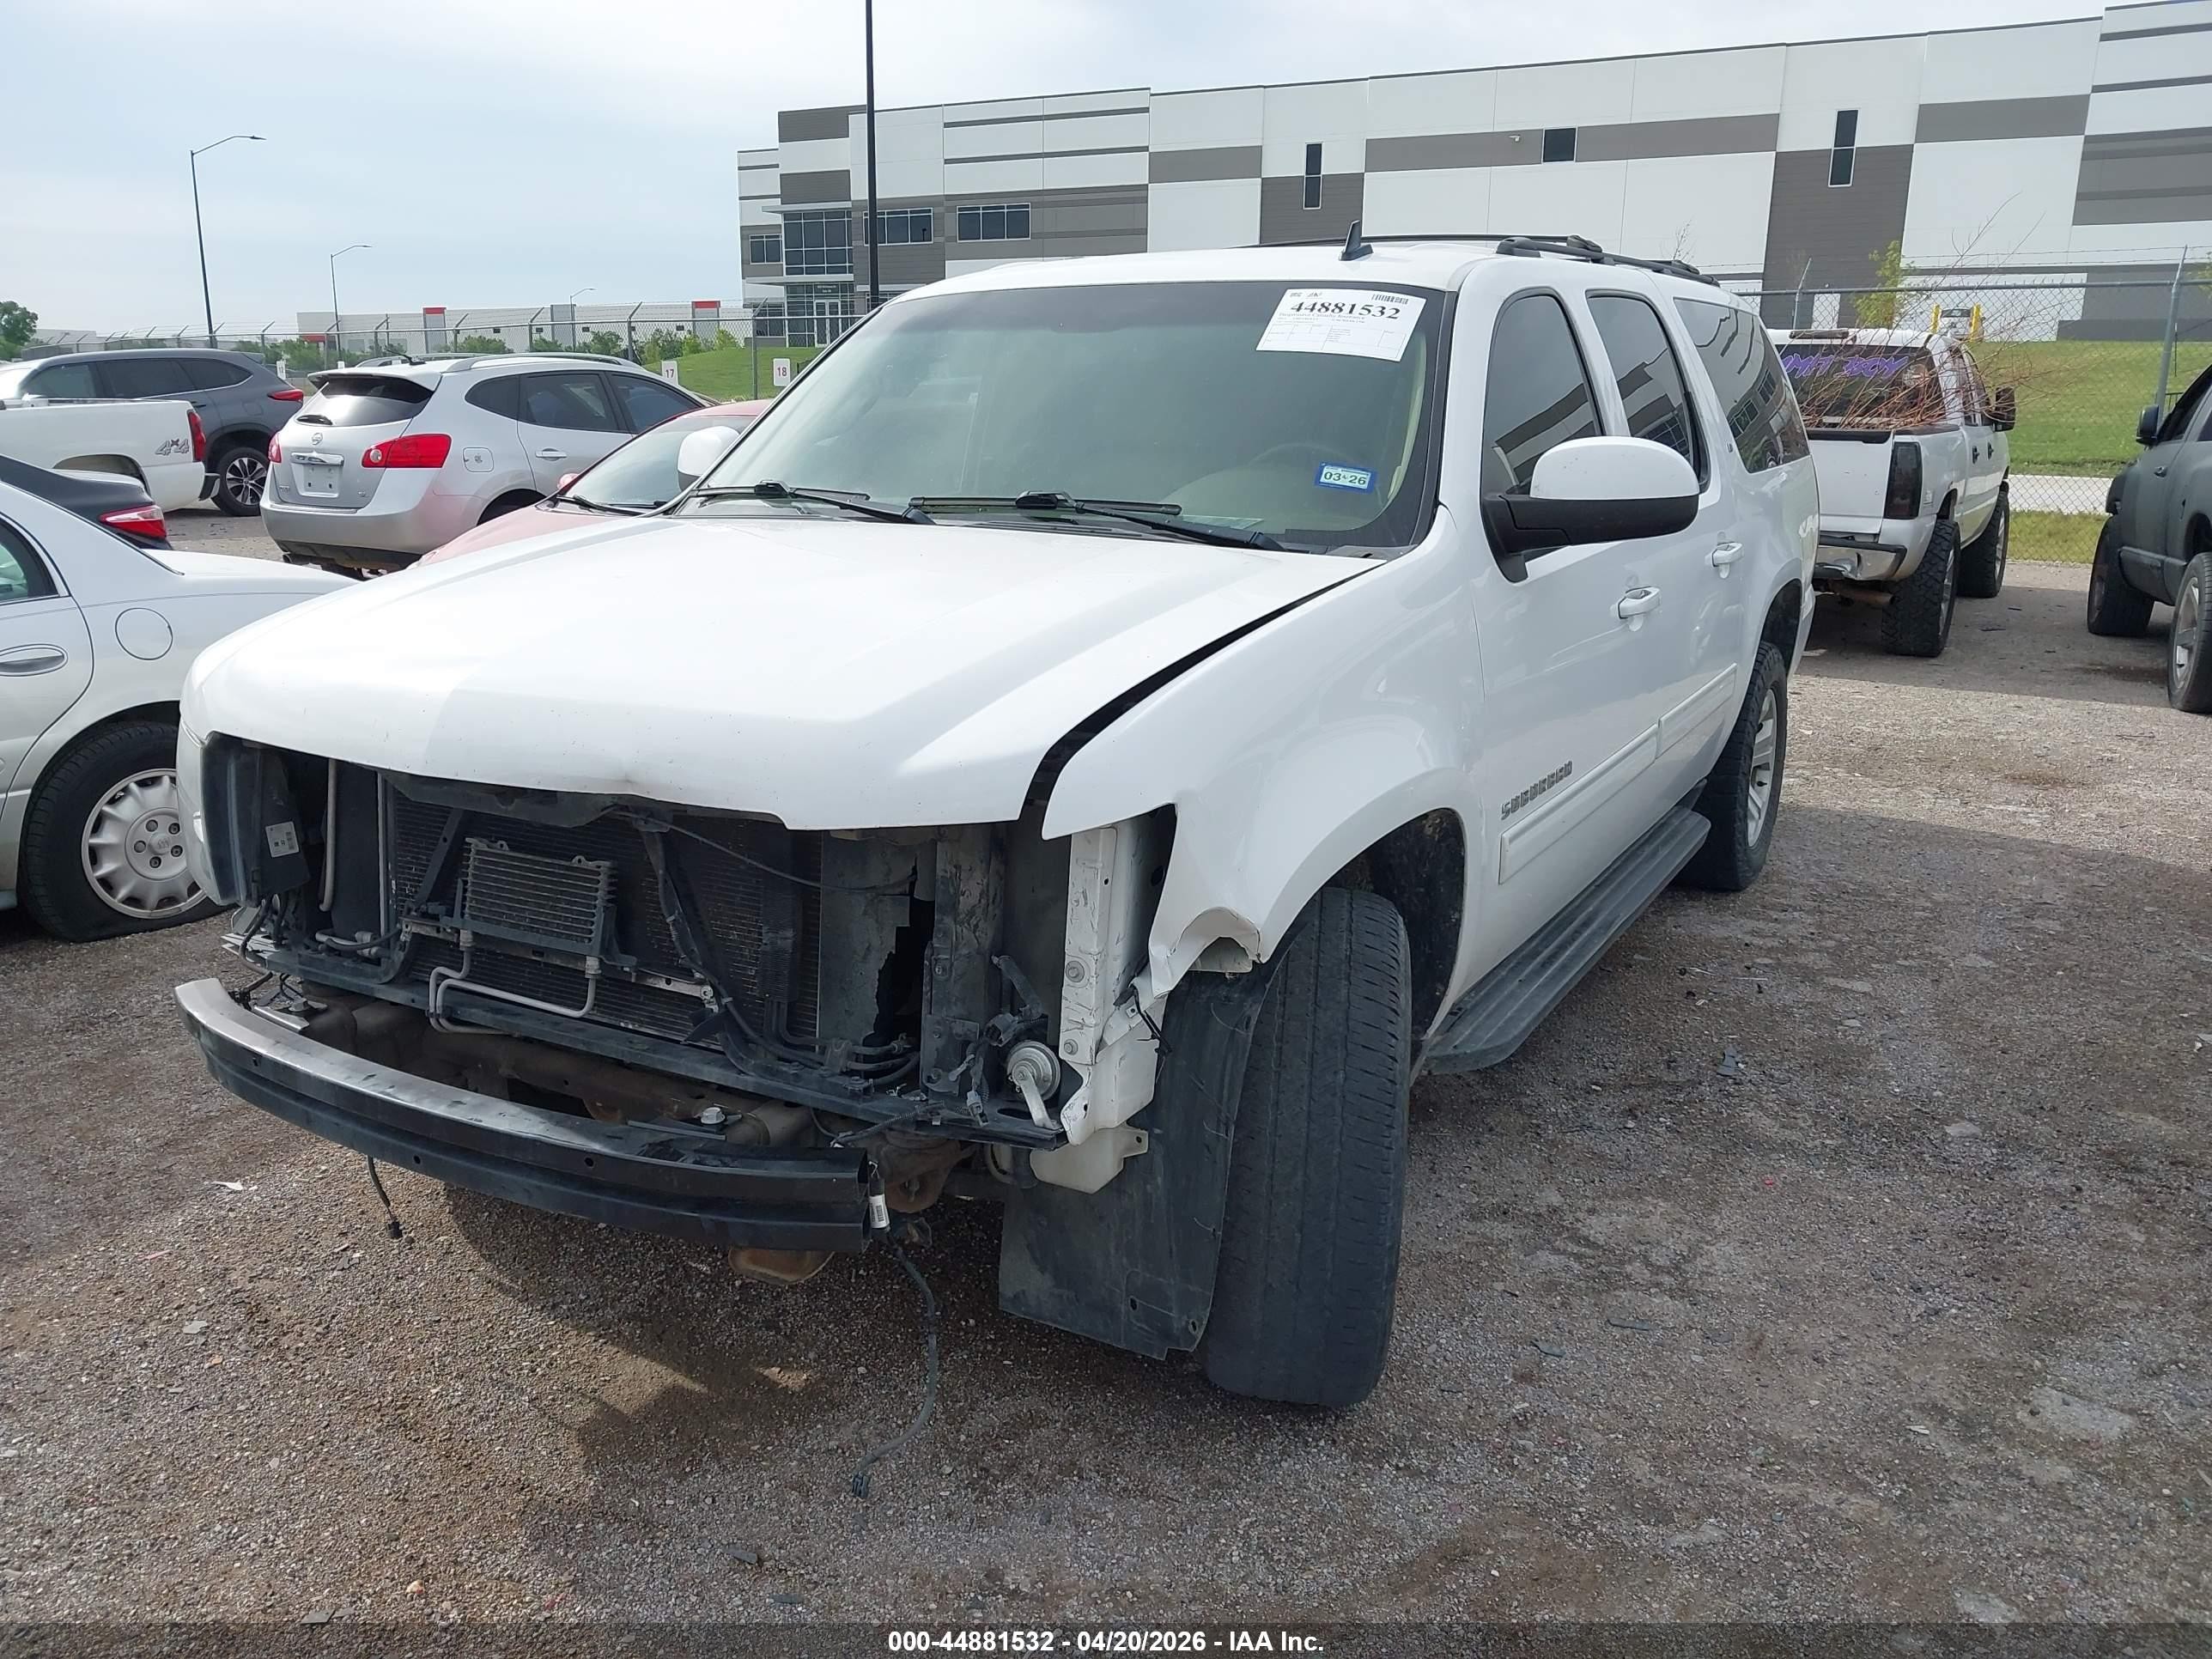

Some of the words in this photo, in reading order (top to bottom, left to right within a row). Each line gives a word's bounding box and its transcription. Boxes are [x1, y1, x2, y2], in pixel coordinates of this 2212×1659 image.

[1291, 301, 1401, 319] 44881532
[665, 368, 674, 379] 17
[777, 367, 787, 377] 18
[1324, 471, 1341, 482] 03
[1348, 475, 1367, 485] 26
[1501, 761, 1572, 821] SUBURBAN
